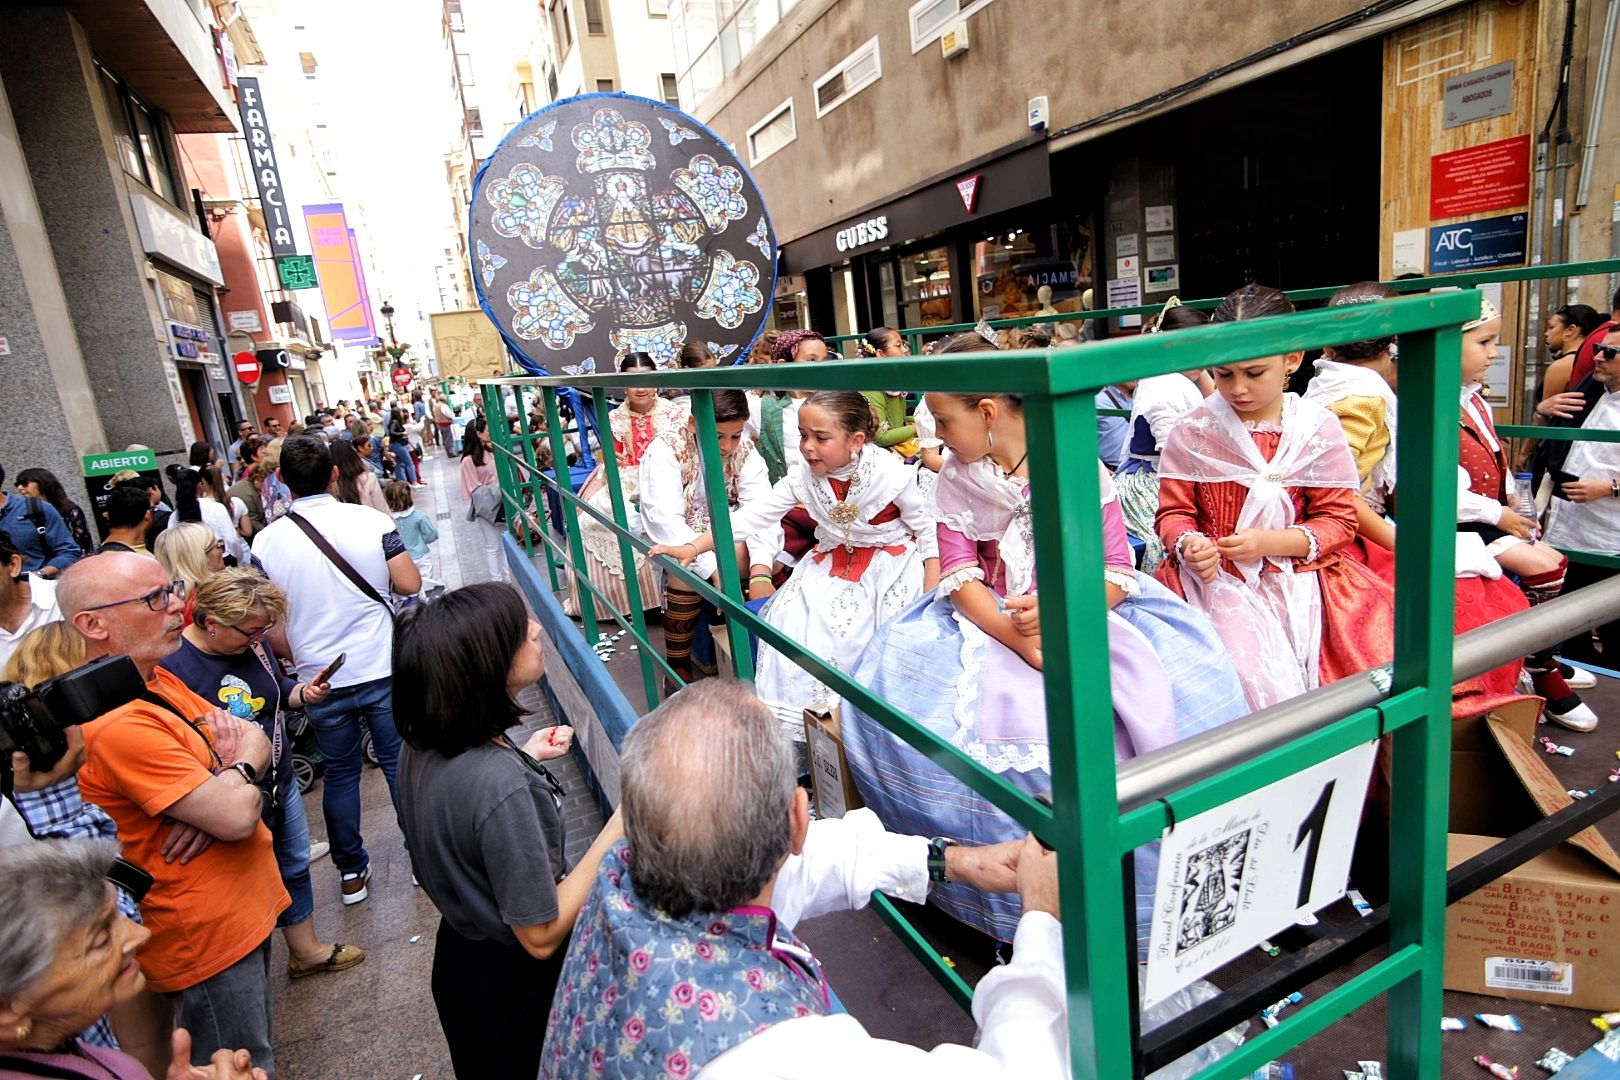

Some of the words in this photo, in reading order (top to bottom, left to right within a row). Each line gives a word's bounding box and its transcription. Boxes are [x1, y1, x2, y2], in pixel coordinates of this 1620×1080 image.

[1463, 76, 1486, 88] CASADO
[1461, 89, 1493, 104] ABOGADOS
[244, 88, 291, 245] FARMACIA
[836, 216, 888, 251] GUESS
[91, 456, 148, 470] ABIERTO
[1293, 778, 1337, 910] 1
[1502, 883, 1512, 894] 8
[1567, 892, 1572, 900] 1
[1576, 894, 1595, 904] Kg.
[1509, 902, 1519, 911] 8
[1567, 910, 1572, 918] 1
[1576, 912, 1595, 922] Kg.
[1488, 927, 1537, 938] CARAMELS
[1506, 919, 1516, 929] 8
[1519, 924, 1550, 933] SACS
[1564, 929, 1582, 938] Kg.
[1474, 936, 1504, 945] weight:
[1507, 937, 1517, 946] 8
[1520, 941, 1552, 951] BAGS
[1566, 947, 1584, 957] Kg.
[1523, 949, 1556, 958] CANDY
